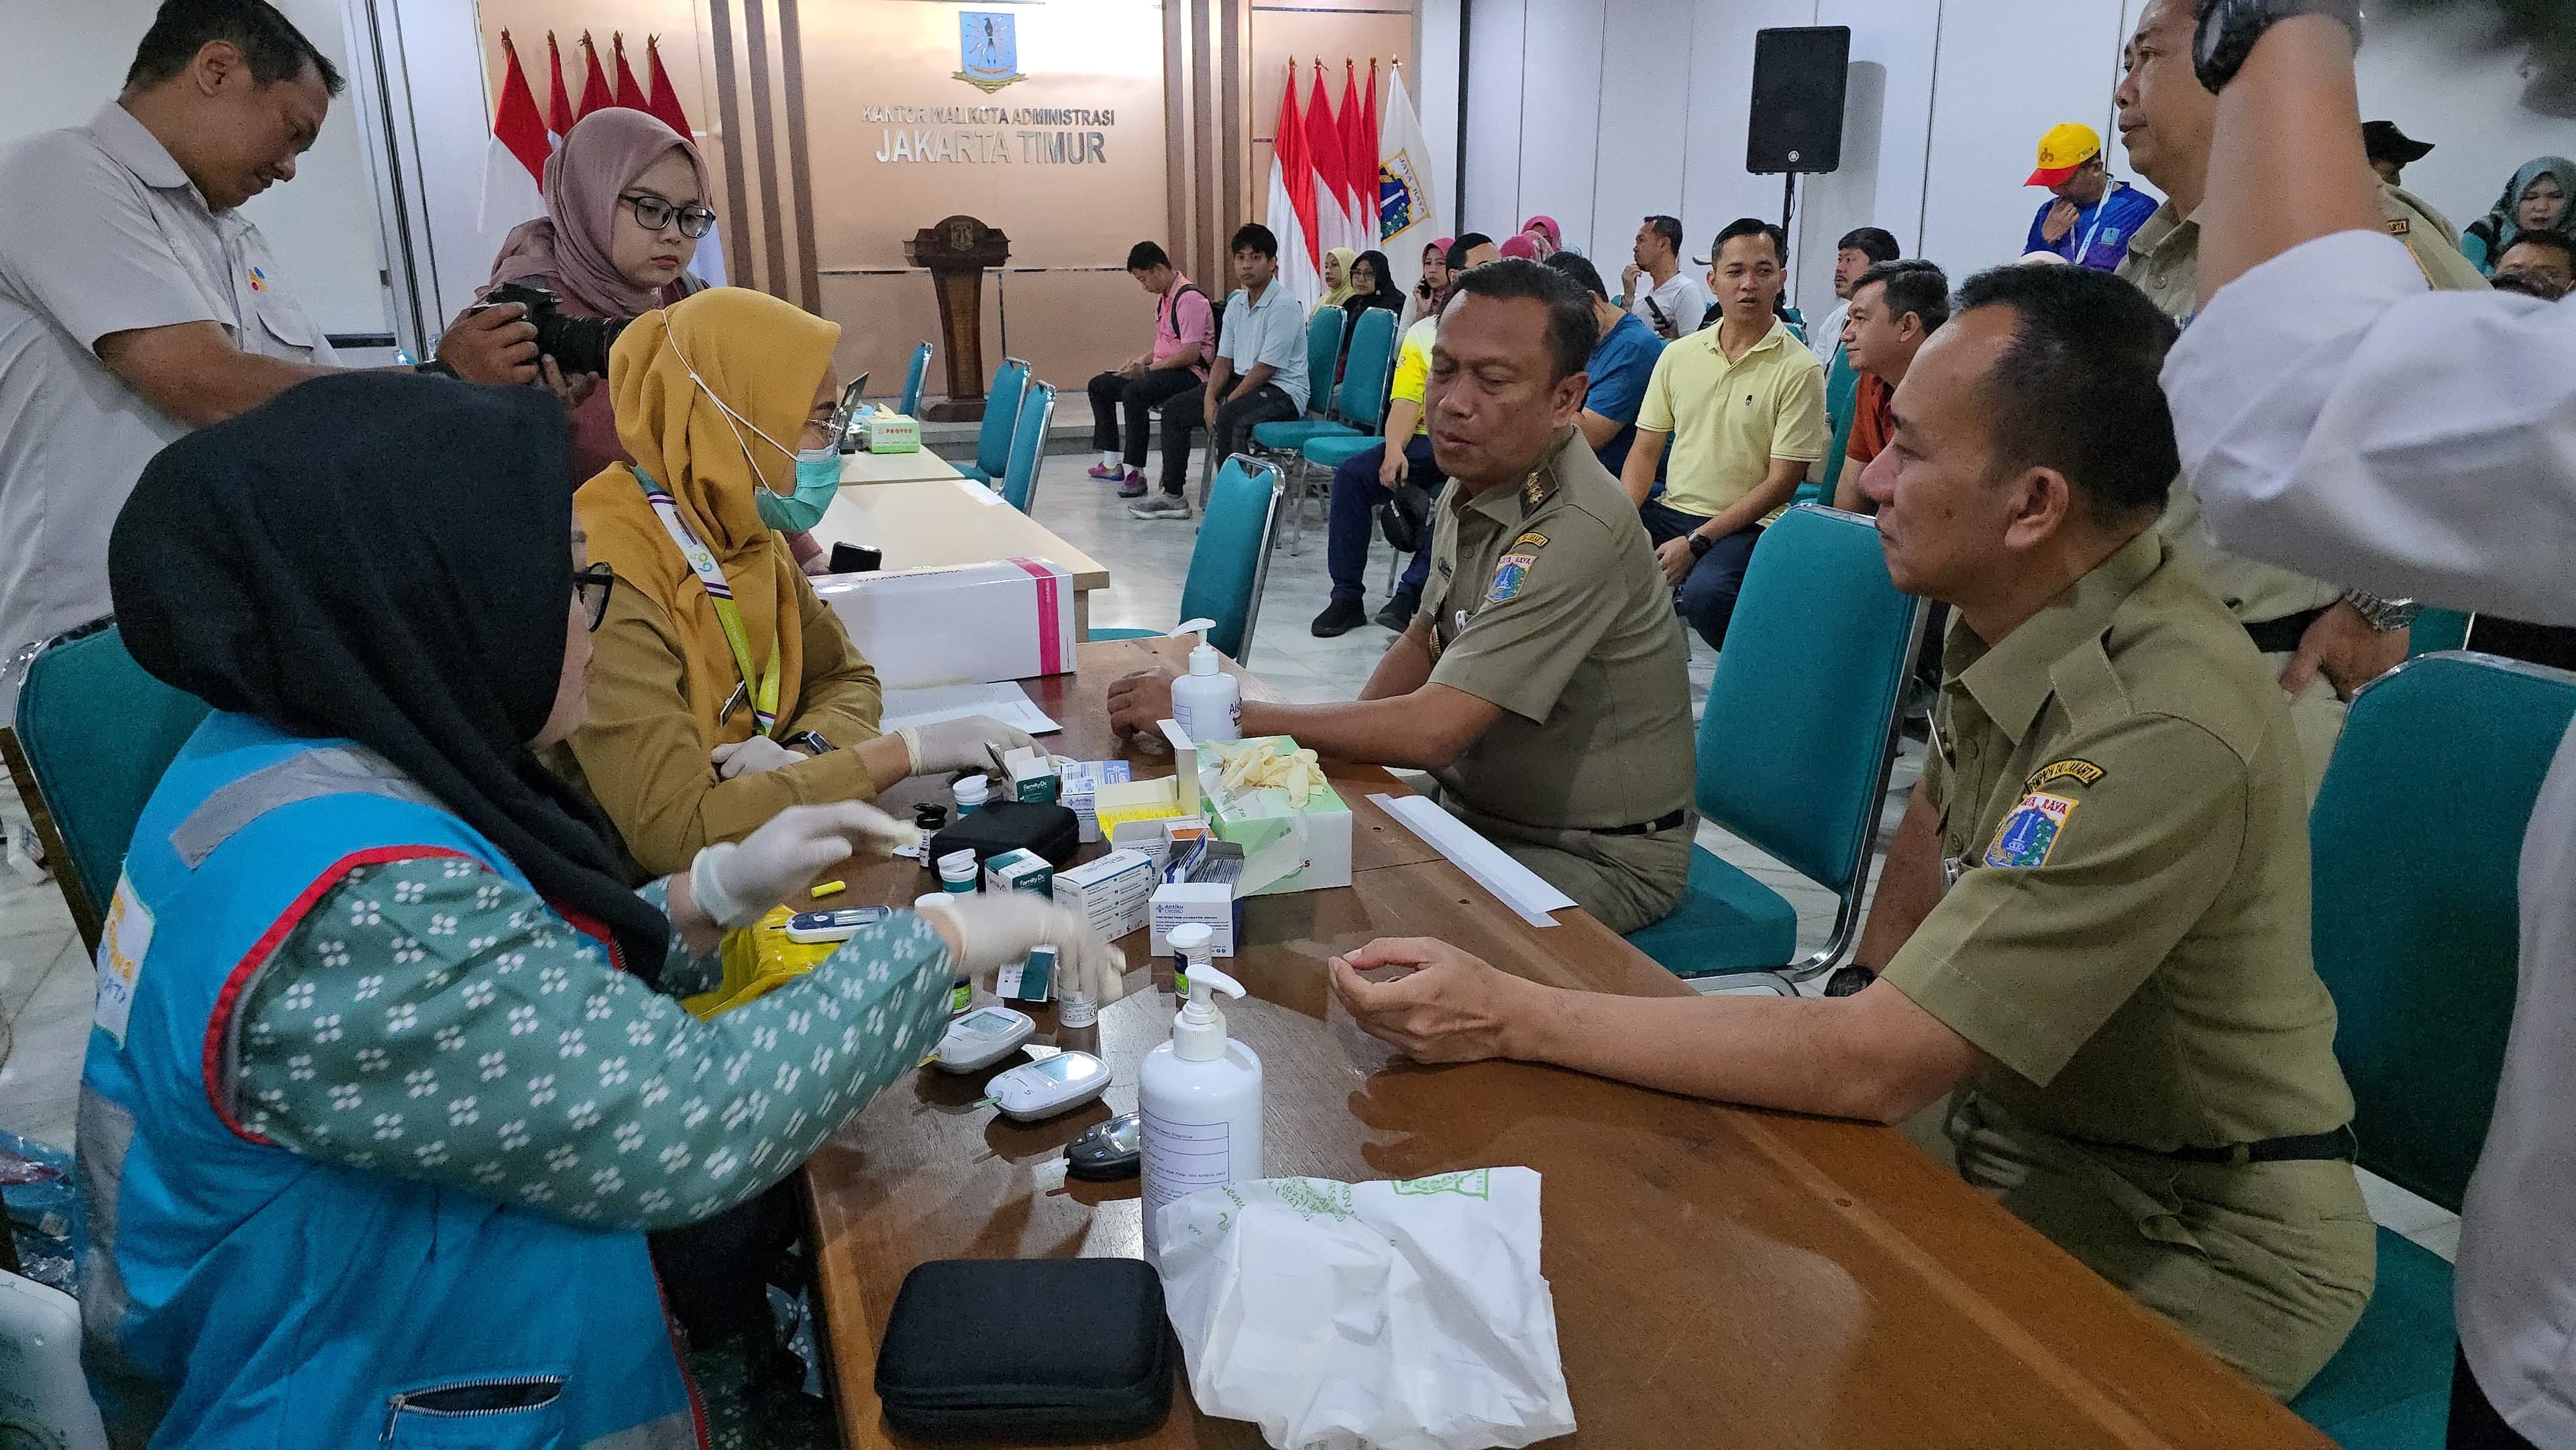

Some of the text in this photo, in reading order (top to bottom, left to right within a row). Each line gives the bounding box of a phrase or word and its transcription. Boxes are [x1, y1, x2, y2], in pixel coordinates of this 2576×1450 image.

[862, 105, 1115, 126] KANTOR WALIKOTA ADMINISTRASI
[876, 129, 1107, 164] JAKARTA TIMUR
[1399, 156, 1413, 182] JAYA
[2041, 798, 2068, 815] RAYA
